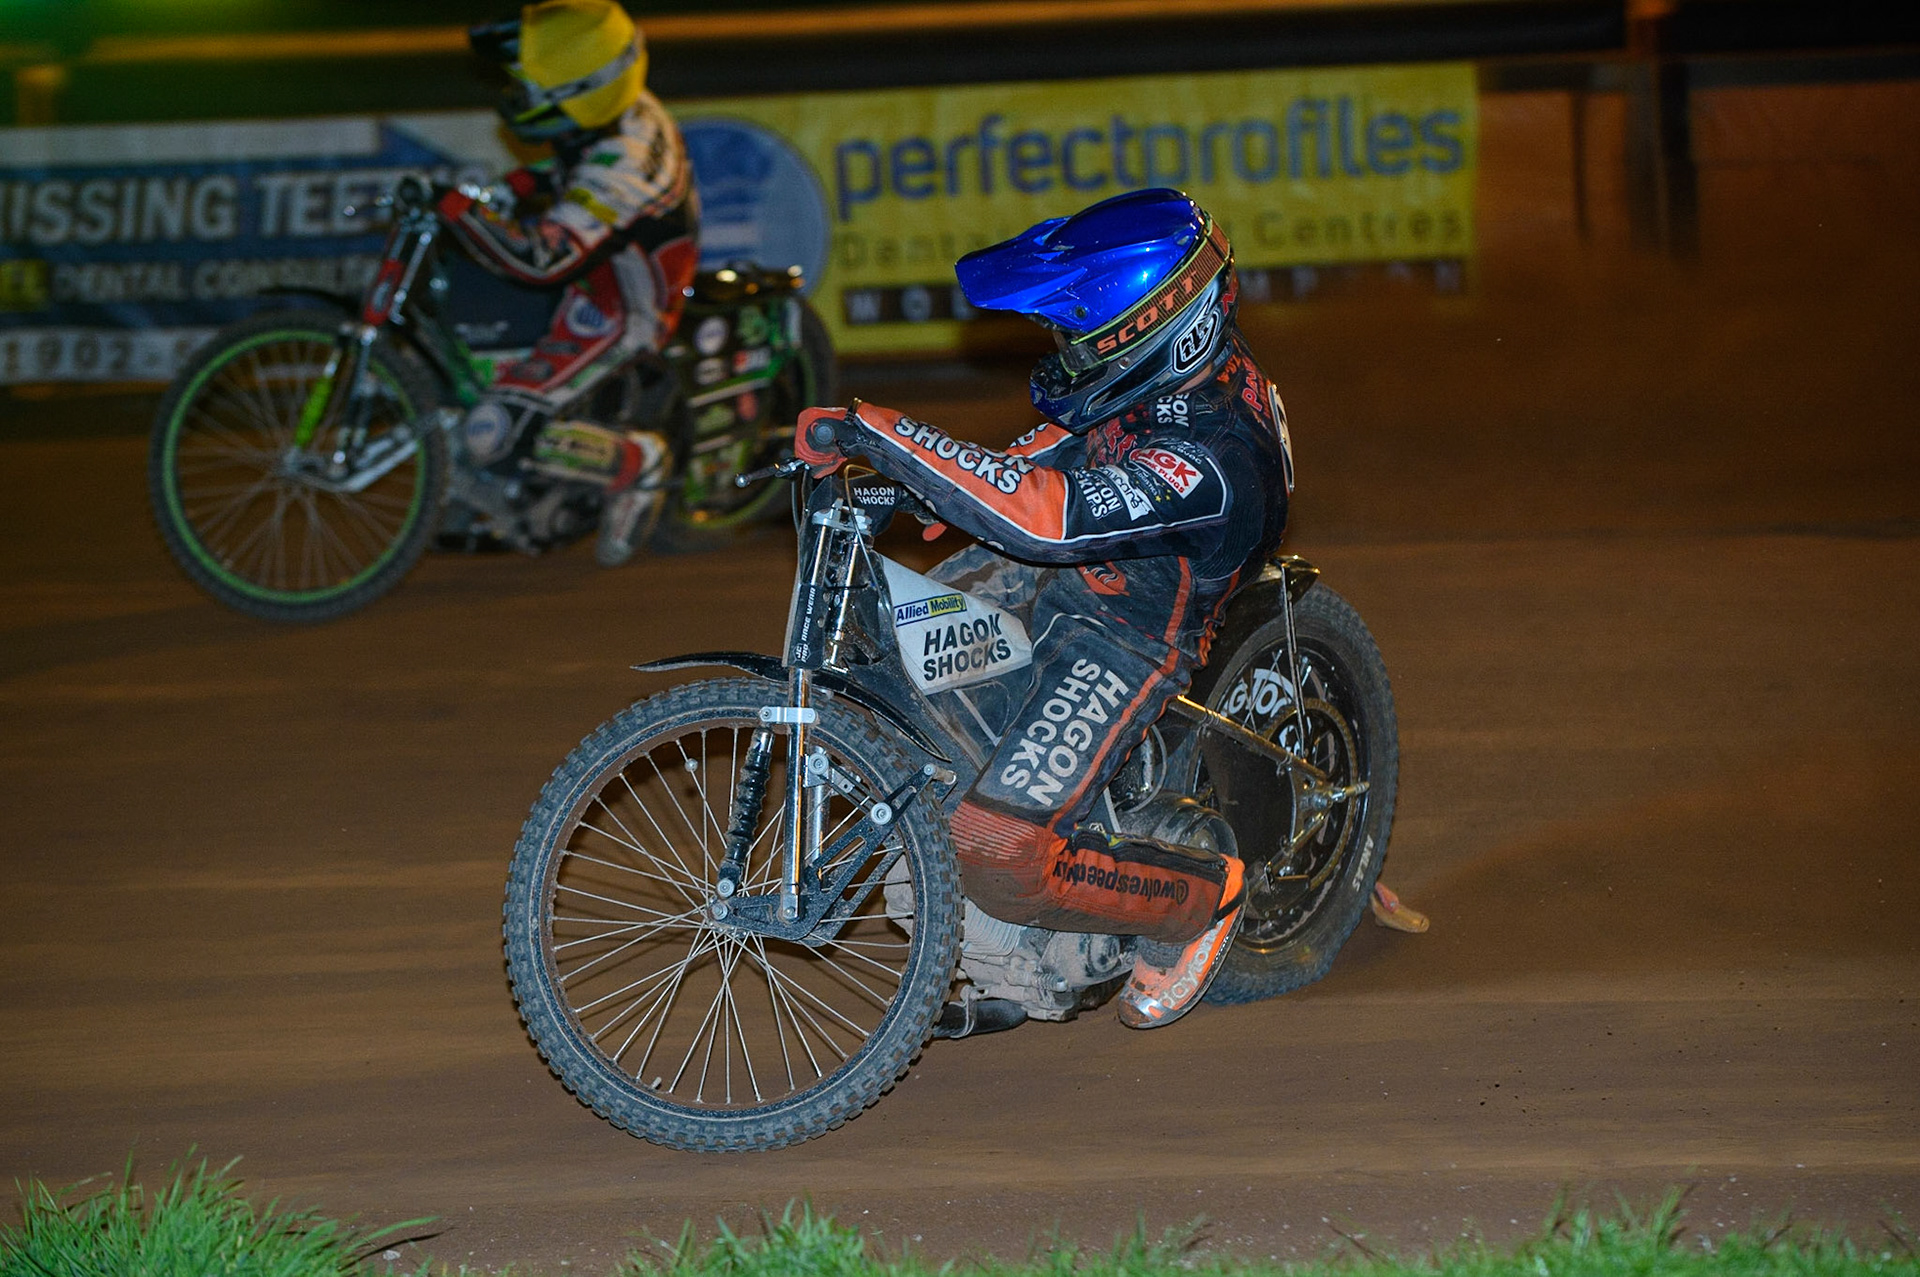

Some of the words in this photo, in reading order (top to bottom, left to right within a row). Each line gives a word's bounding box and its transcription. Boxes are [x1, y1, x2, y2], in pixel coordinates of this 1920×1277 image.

[834, 95, 1465, 221] perfectprofiles
[0, 172, 238, 246] ISSING
[1254, 208, 1461, 248] Centres
[1097, 270, 1197, 355] SCOTT
[894, 415, 1021, 495] SHOCKS
[1157, 467, 1185, 494] PLUGS
[853, 486, 895, 497] HAGON
[895, 602, 929, 622] Allied
[930, 593, 967, 614] Mobility
[923, 613, 1002, 657] HAGON
[923, 638, 1012, 682] SHOCKS
[1000, 658, 1101, 789] SHOCKS
[1026, 669, 1130, 807] HAGON
